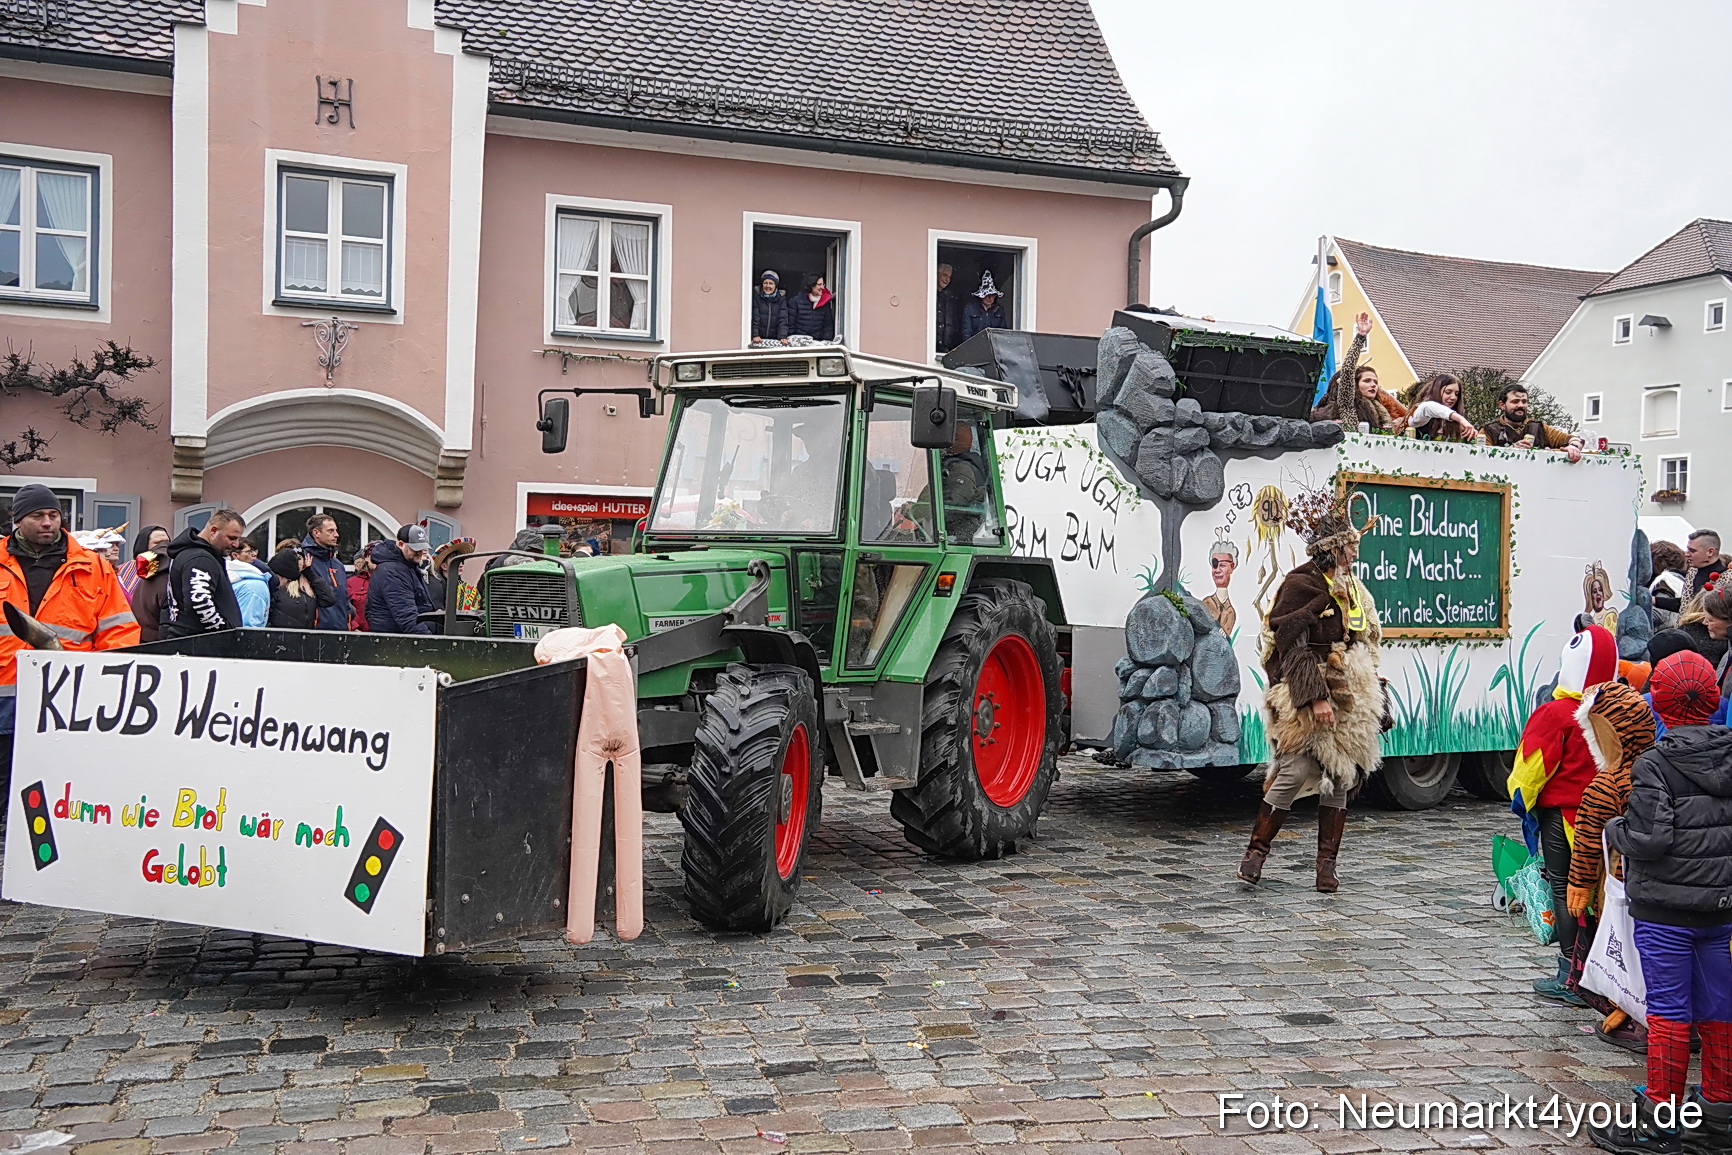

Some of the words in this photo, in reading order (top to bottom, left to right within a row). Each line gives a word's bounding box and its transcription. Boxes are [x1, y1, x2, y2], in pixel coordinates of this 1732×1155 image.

[966, 385, 987, 398] FENDT
[1015, 450, 1068, 484] UGA
[1080, 464, 1122, 525] UGA
[551, 500, 598, 514] idee+spiel
[602, 502, 646, 514] HUTTER
[1347, 491, 1402, 537] Ohne
[1409, 493, 1479, 556] Bildung
[1060, 511, 1118, 574] BAM
[1374, 550, 1397, 581] die
[505, 605, 563, 620] FENDT
[1397, 600, 1411, 624] in
[1413, 596, 1433, 624] die
[1435, 593, 1498, 625] Steinzeit
[524, 625, 540, 639] NM
[36, 660, 162, 736] KLJB
[173, 668, 391, 772] Weidenwang
[53, 782, 112, 825] dumm
[121, 793, 160, 829] wie
[172, 787, 227, 831] Brot
[239, 811, 285, 841] wär
[294, 804, 350, 848] noch
[141, 843, 228, 888] Gelobt
